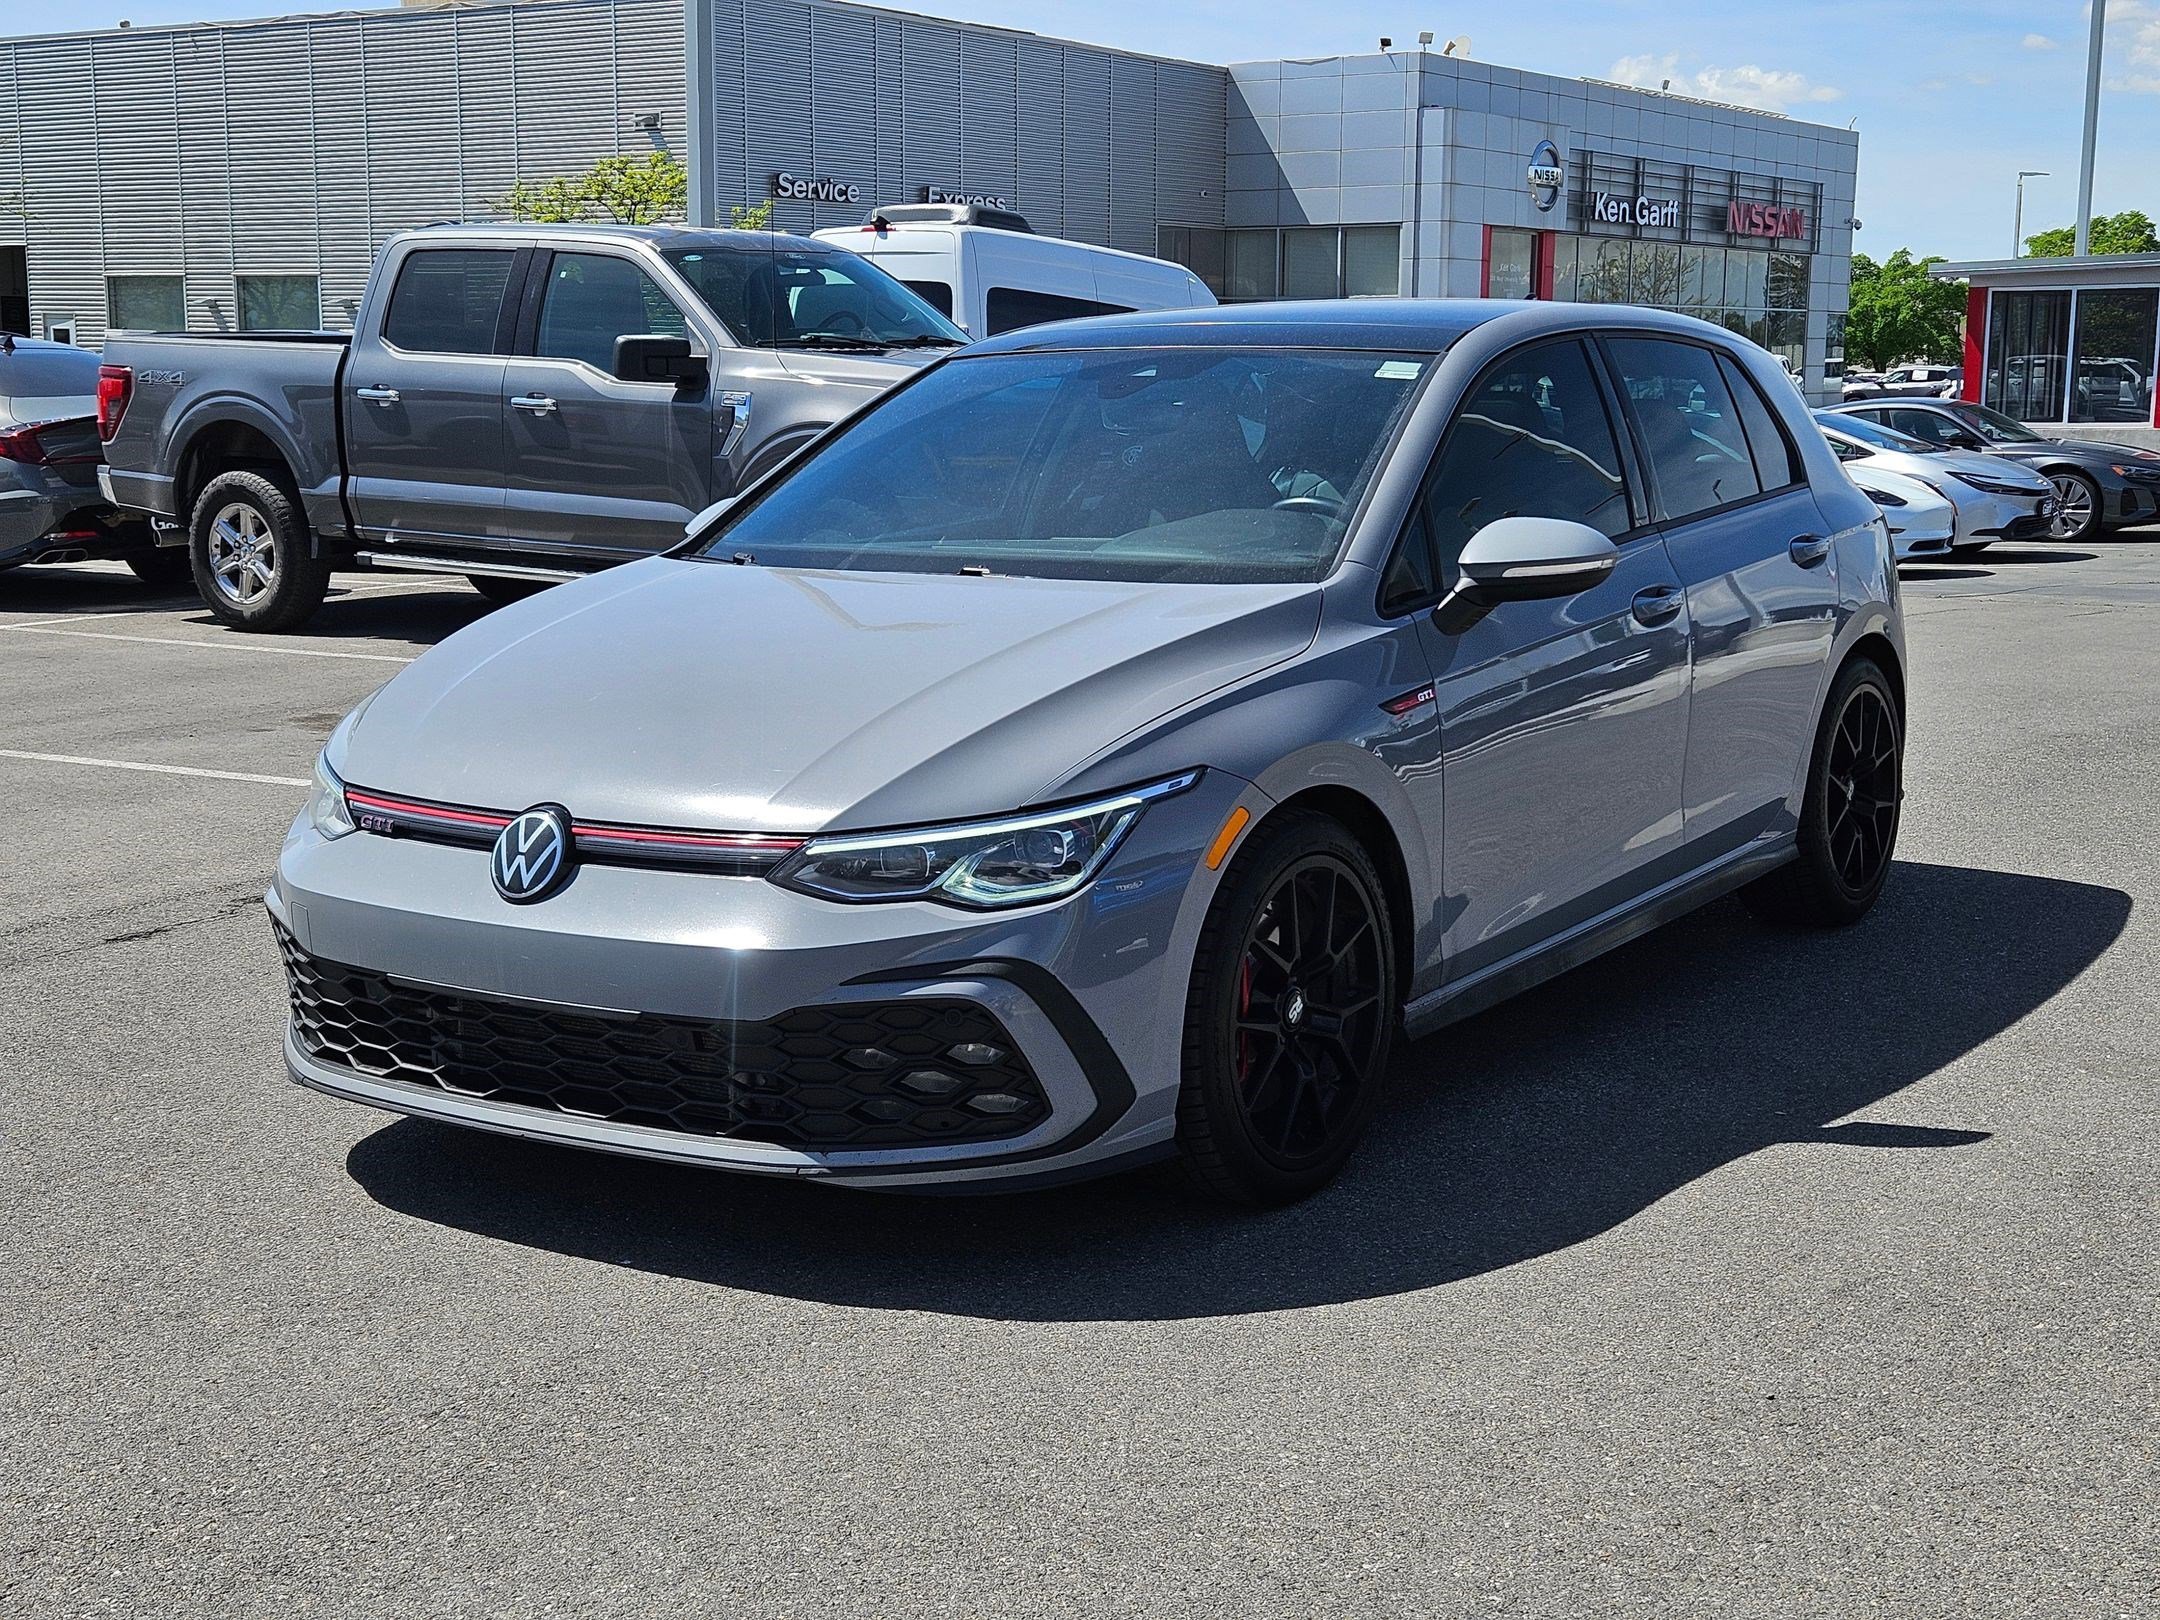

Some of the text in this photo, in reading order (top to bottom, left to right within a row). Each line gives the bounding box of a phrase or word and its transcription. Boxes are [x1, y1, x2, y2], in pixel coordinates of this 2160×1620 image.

[777, 172, 860, 203] Service
[1594, 191, 1679, 228] Ken Garff
[1728, 201, 1805, 239] NISSAN
[1417, 688, 1434, 702] GTI
[360, 814, 394, 833] GTI
